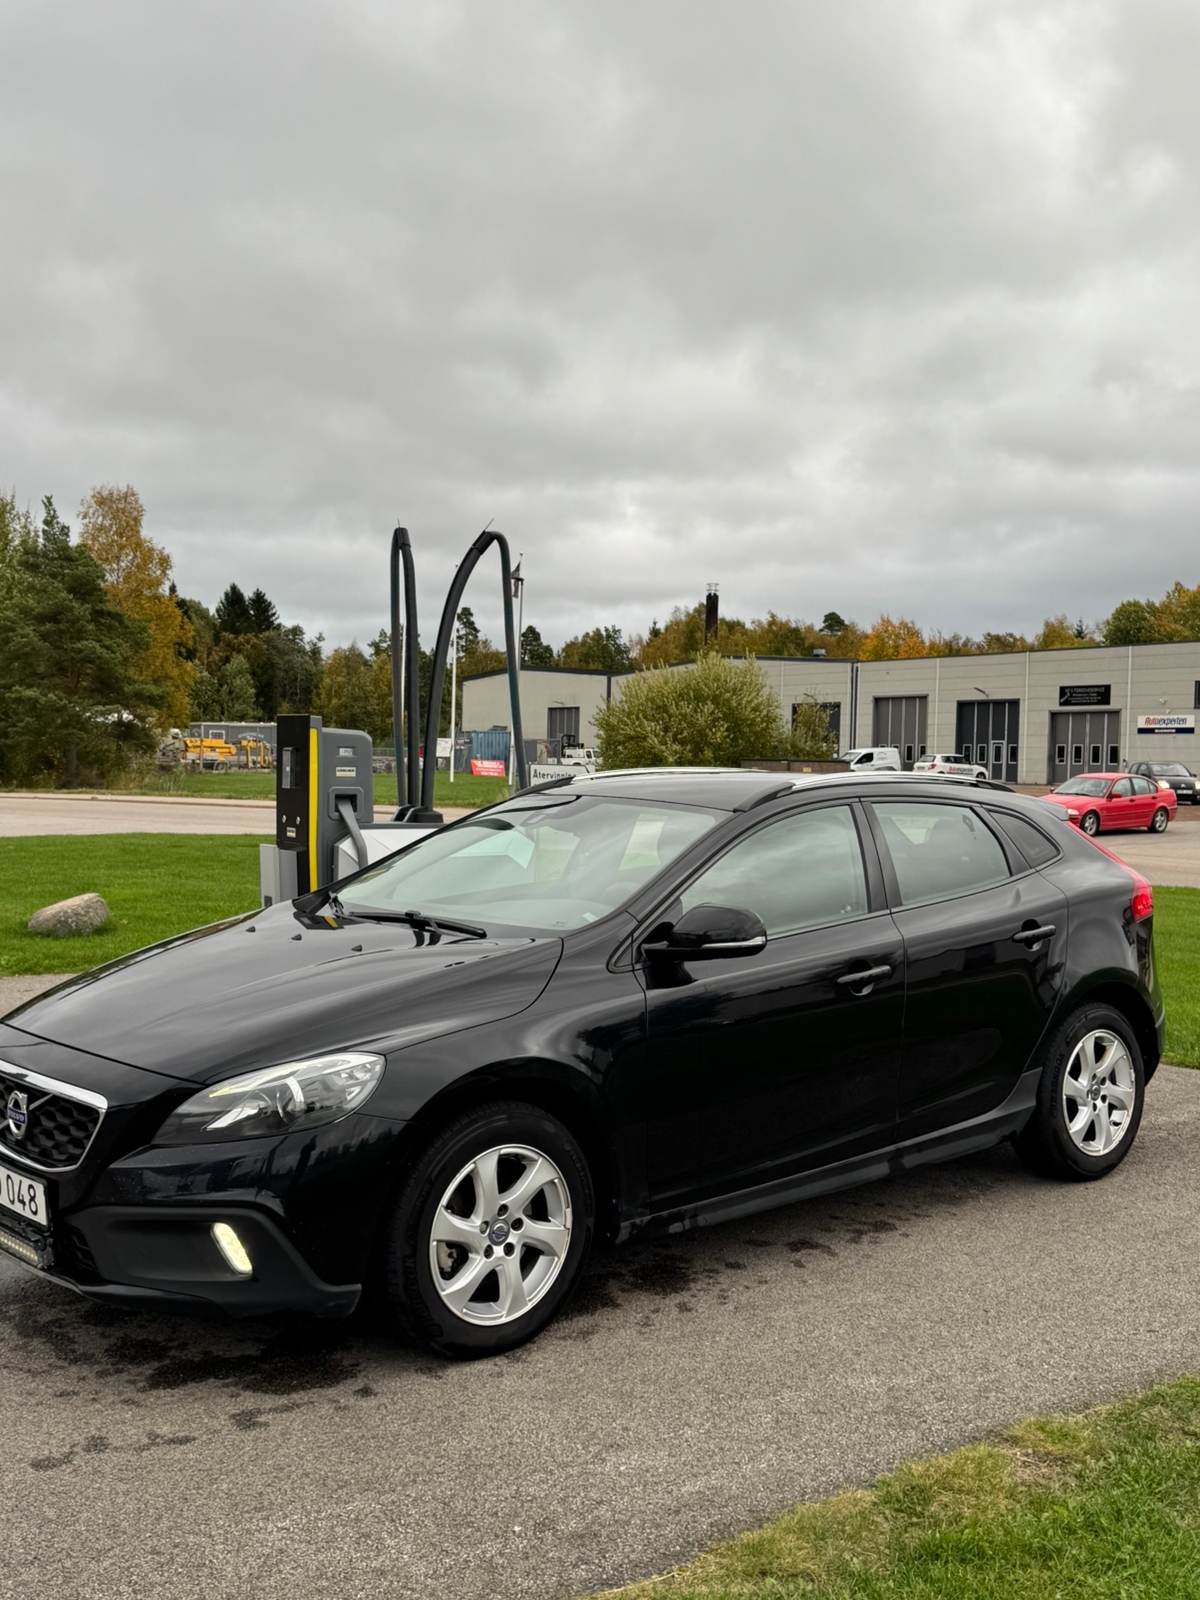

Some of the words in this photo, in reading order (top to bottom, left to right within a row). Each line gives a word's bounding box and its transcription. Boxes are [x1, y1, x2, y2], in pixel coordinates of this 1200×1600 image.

[1144, 716, 1187, 726] Autoexperten
[532, 768, 576, 779] Återvinnin
[9, 1110, 24, 1122] VOLVO
[6, 1173, 38, 1216] 048
